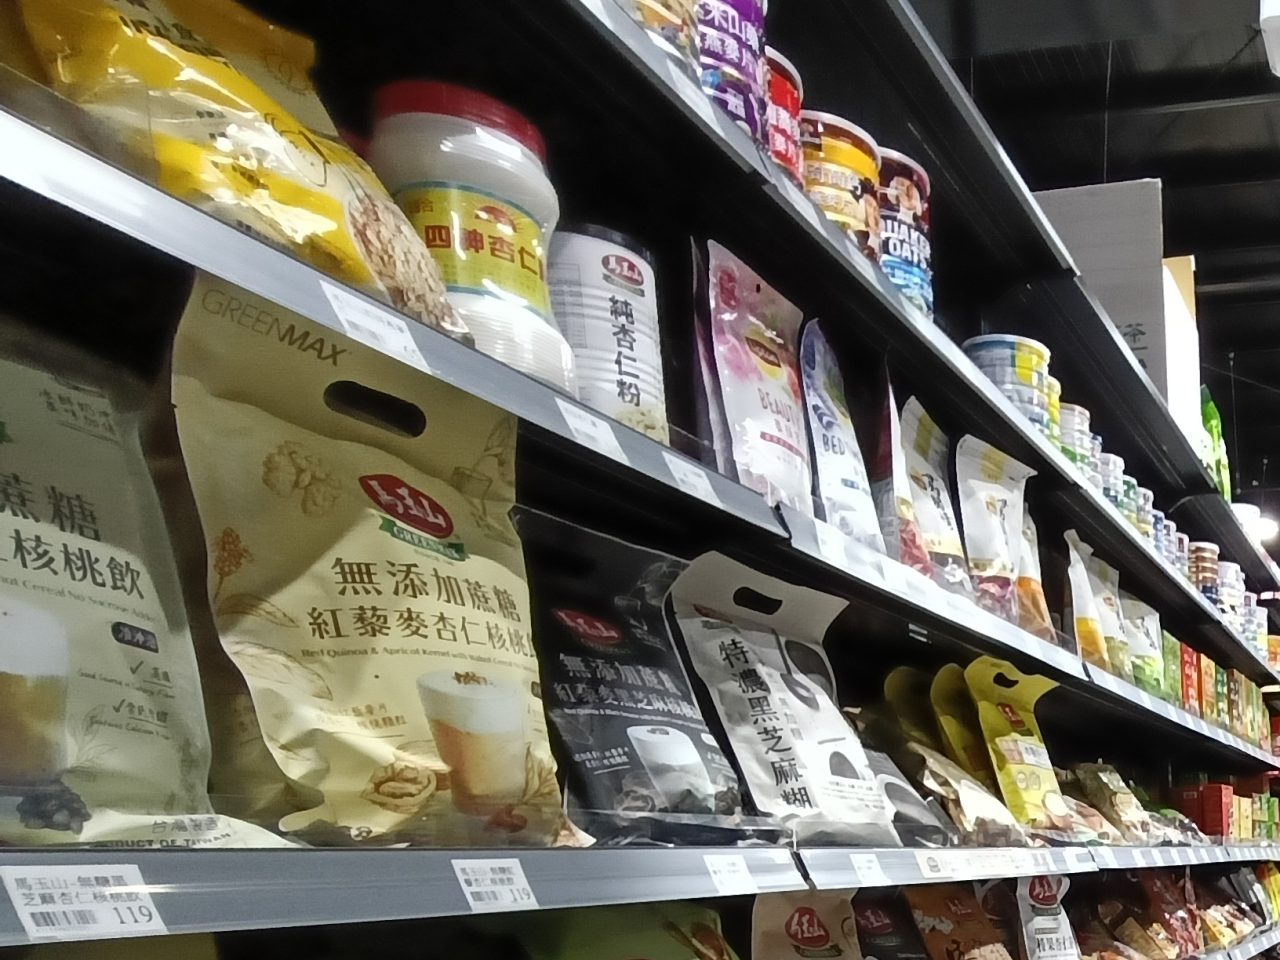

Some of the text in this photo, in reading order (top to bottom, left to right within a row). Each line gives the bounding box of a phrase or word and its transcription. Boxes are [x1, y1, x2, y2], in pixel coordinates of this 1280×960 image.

[202, 289, 347, 367] GREENMAX
[608, 294, 641, 408] 純杏仁粉
[331, 556, 521, 625] 無添加蔗糖
[717, 637, 814, 810] 特濃黑芝麻糊
[112, 904, 154, 925] 119
[509, 887, 531, 903] 119
